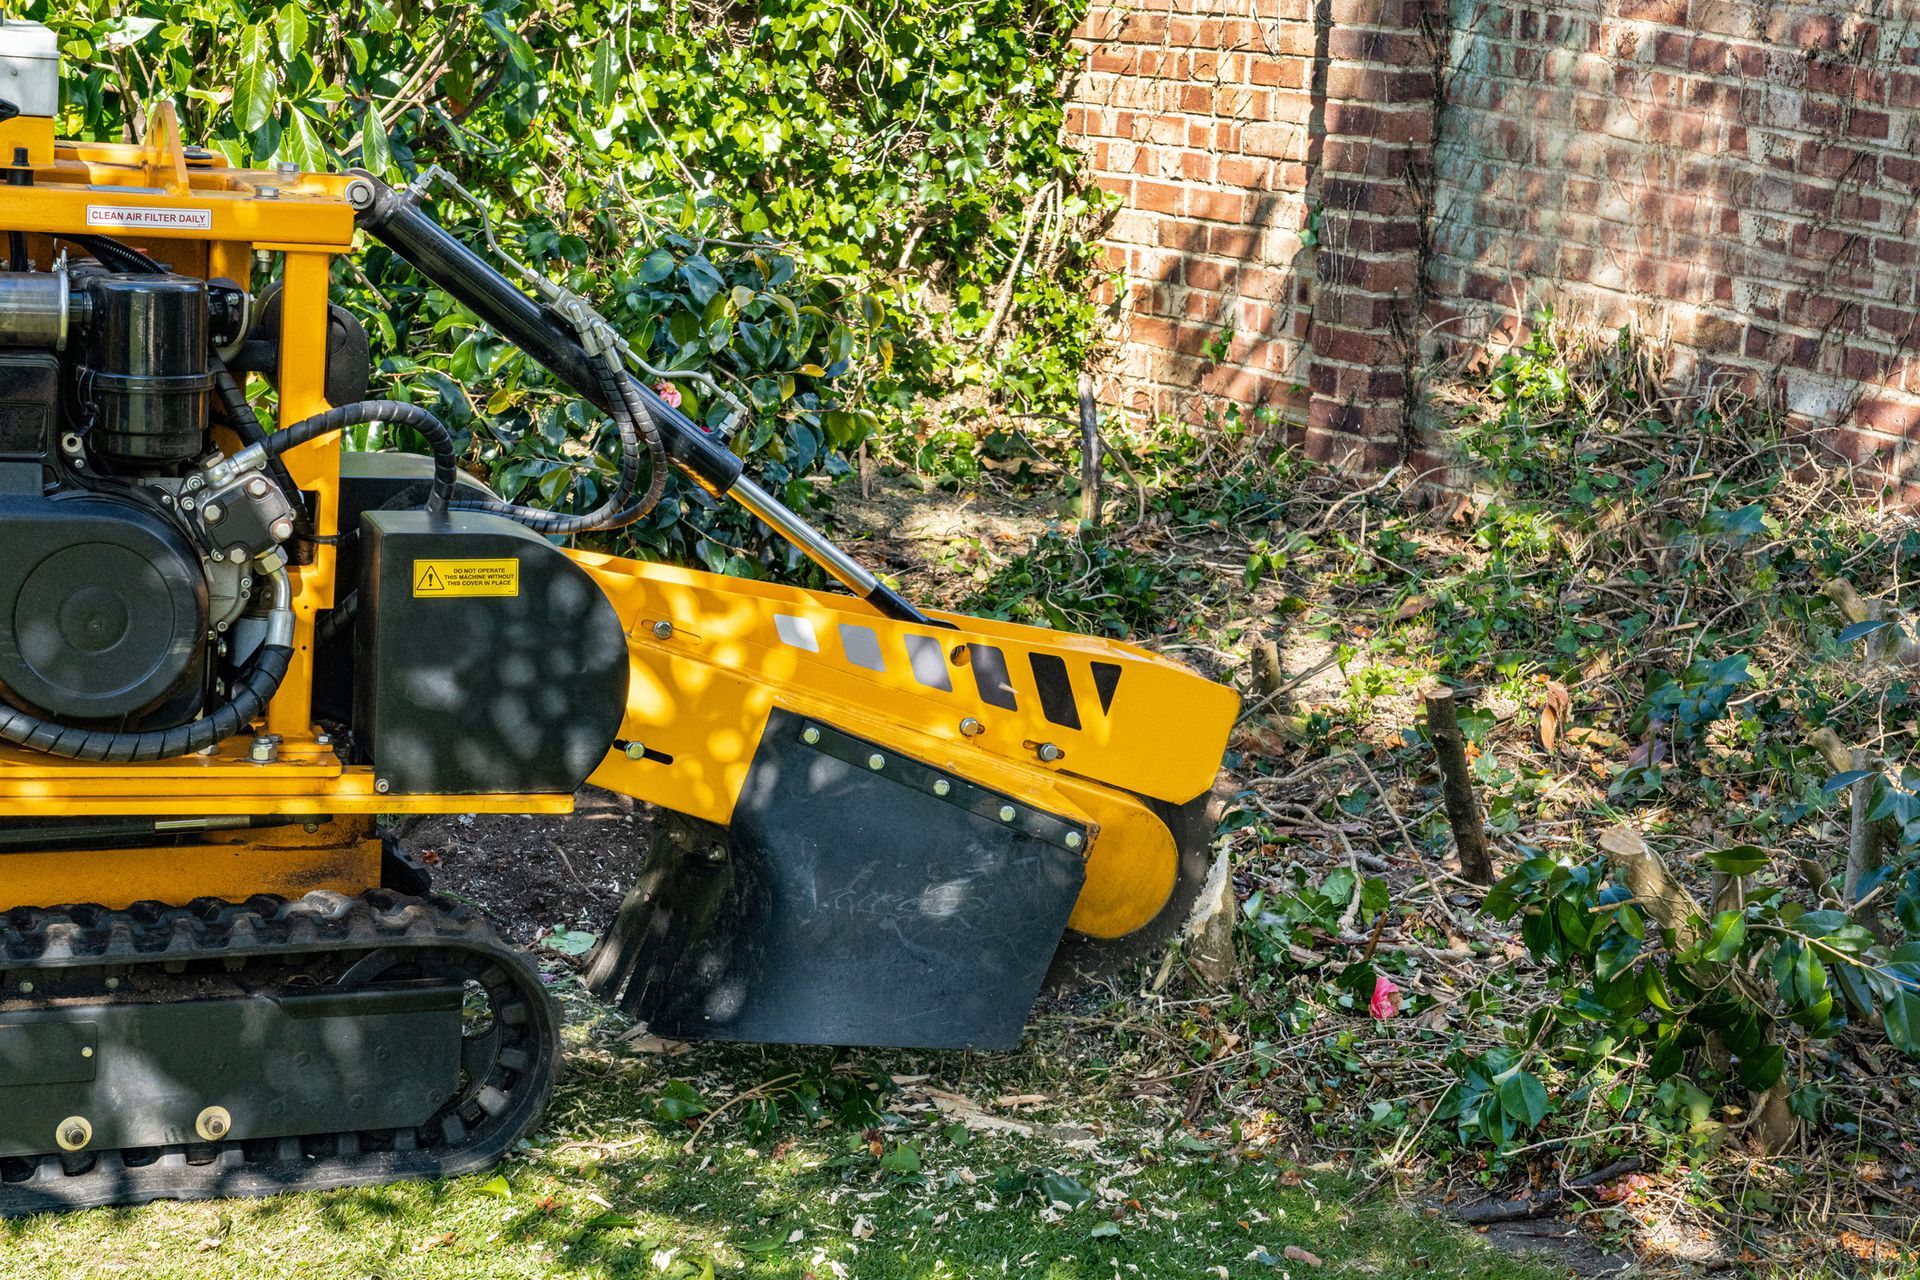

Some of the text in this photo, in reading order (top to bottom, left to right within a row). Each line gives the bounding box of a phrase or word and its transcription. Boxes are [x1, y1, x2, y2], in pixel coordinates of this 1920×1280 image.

[91, 211, 206, 224] CLEAN AIR FILTER DAILY
